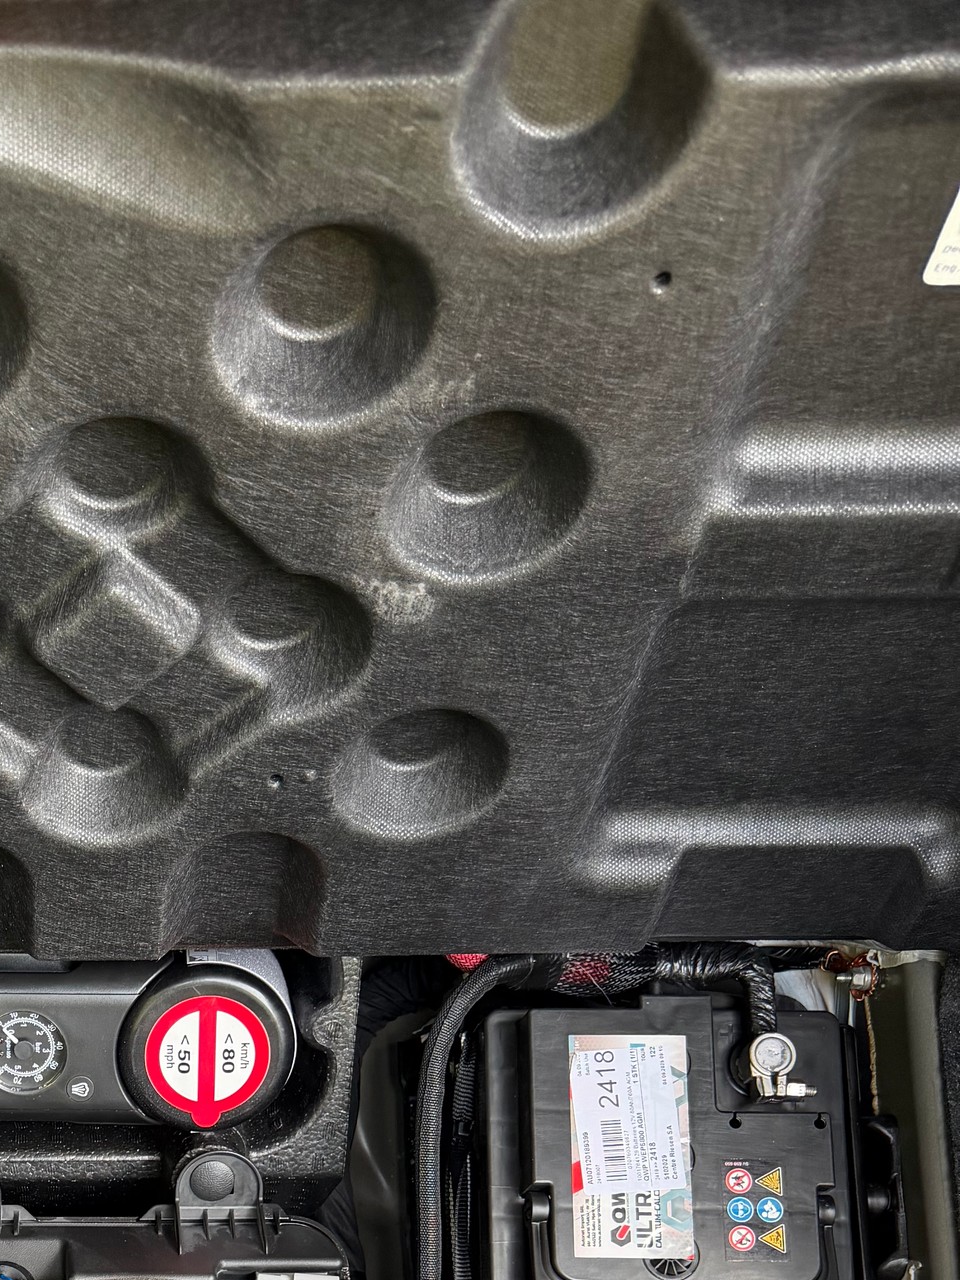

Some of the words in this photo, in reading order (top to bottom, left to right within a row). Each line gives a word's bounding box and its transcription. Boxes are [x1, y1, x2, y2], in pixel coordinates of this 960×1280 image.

[48, 1024, 56, 1032] 30
[35, 1041, 43, 1054] bar
[56, 1041, 64, 1051] 40
[164, 1044, 175, 1069] mph
[240, 1042, 250, 1070] km/h
[49, 1061, 59, 1070] 50
[177, 1049, 191, 1074] 50
[222, 1048, 236, 1074] 80
[13, 1077, 22, 1085] 70
[34, 1074, 43, 1083] 60
[593, 1050, 620, 1109] 2418
[649, 1141, 658, 1161] 2418
[642, 1164, 650, 1182] QWP
[661, 1154, 670, 1180] 5102029
[670, 1158, 678, 1180] Centre
[612, 1192, 626, 1224] QW
[635, 1191, 653, 1248] ULTR
